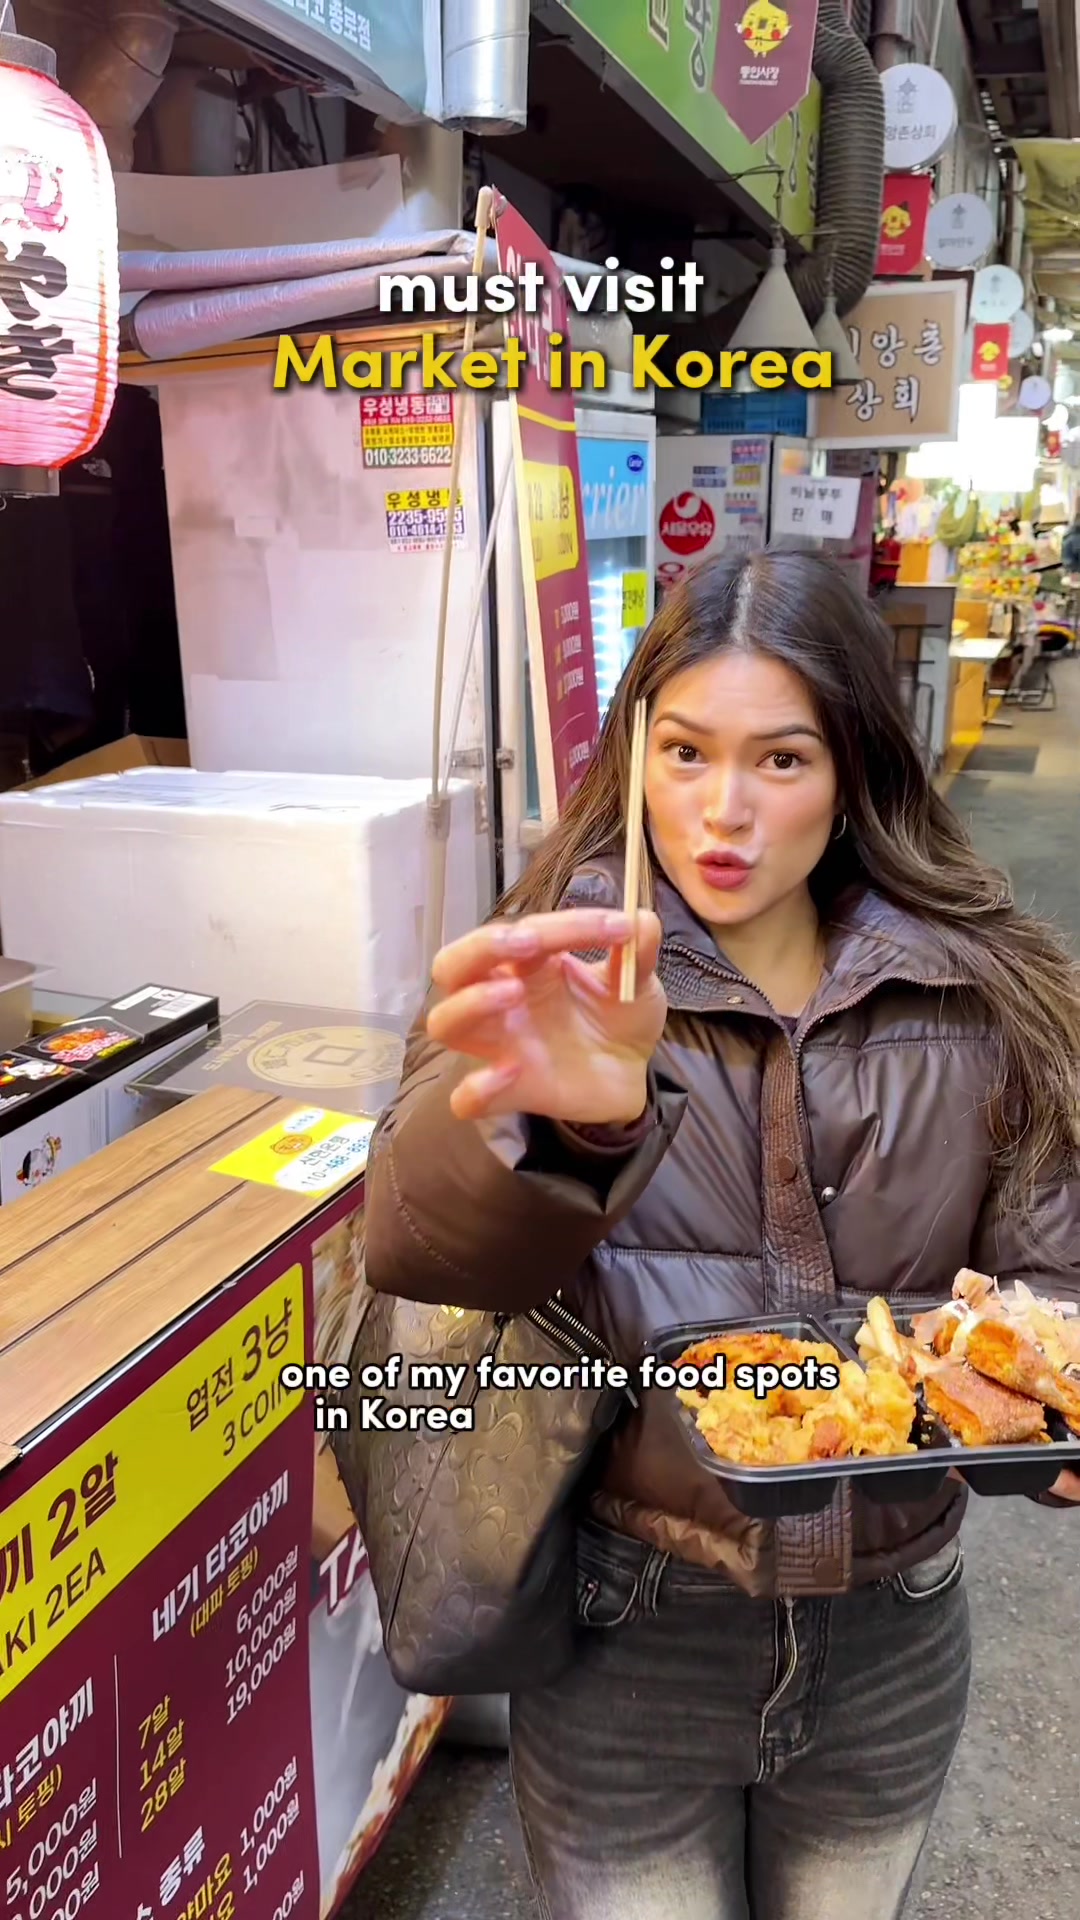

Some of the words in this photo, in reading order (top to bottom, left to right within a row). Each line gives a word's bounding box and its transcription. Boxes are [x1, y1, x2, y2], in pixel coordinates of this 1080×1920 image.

[363, 395, 426, 417] 우성냉동
[186, 1356, 234, 1432] 엽전
[241, 1297, 293, 1382] 3냥
[222, 1420, 236, 1457] 3
[46, 1450, 119, 1562] 2알
[45, 1546, 106, 1630] 2EA
[152, 1564, 200, 1643] 네기
[205, 1469, 289, 1585] 타코야끼
[190, 1583, 225, 1639] (대파
[226, 1545, 259, 1598] 토핑)
[236, 1544, 298, 1635] 6,000원
[225, 1580, 297, 1689] 10,000원
[226, 1617, 296, 1726] 19,000원
[138, 1694, 172, 1751] 7알
[139, 1718, 186, 1792] 14알
[6, 1776, 97, 1906] 5,000원
[17, 1762, 63, 1833] 토핑)
[140, 1757, 188, 1833] 28알
[239, 1755, 299, 1858] 1,000원
[158, 1824, 206, 1908] 종류
[242, 1791, 301, 1895] 1,000원
